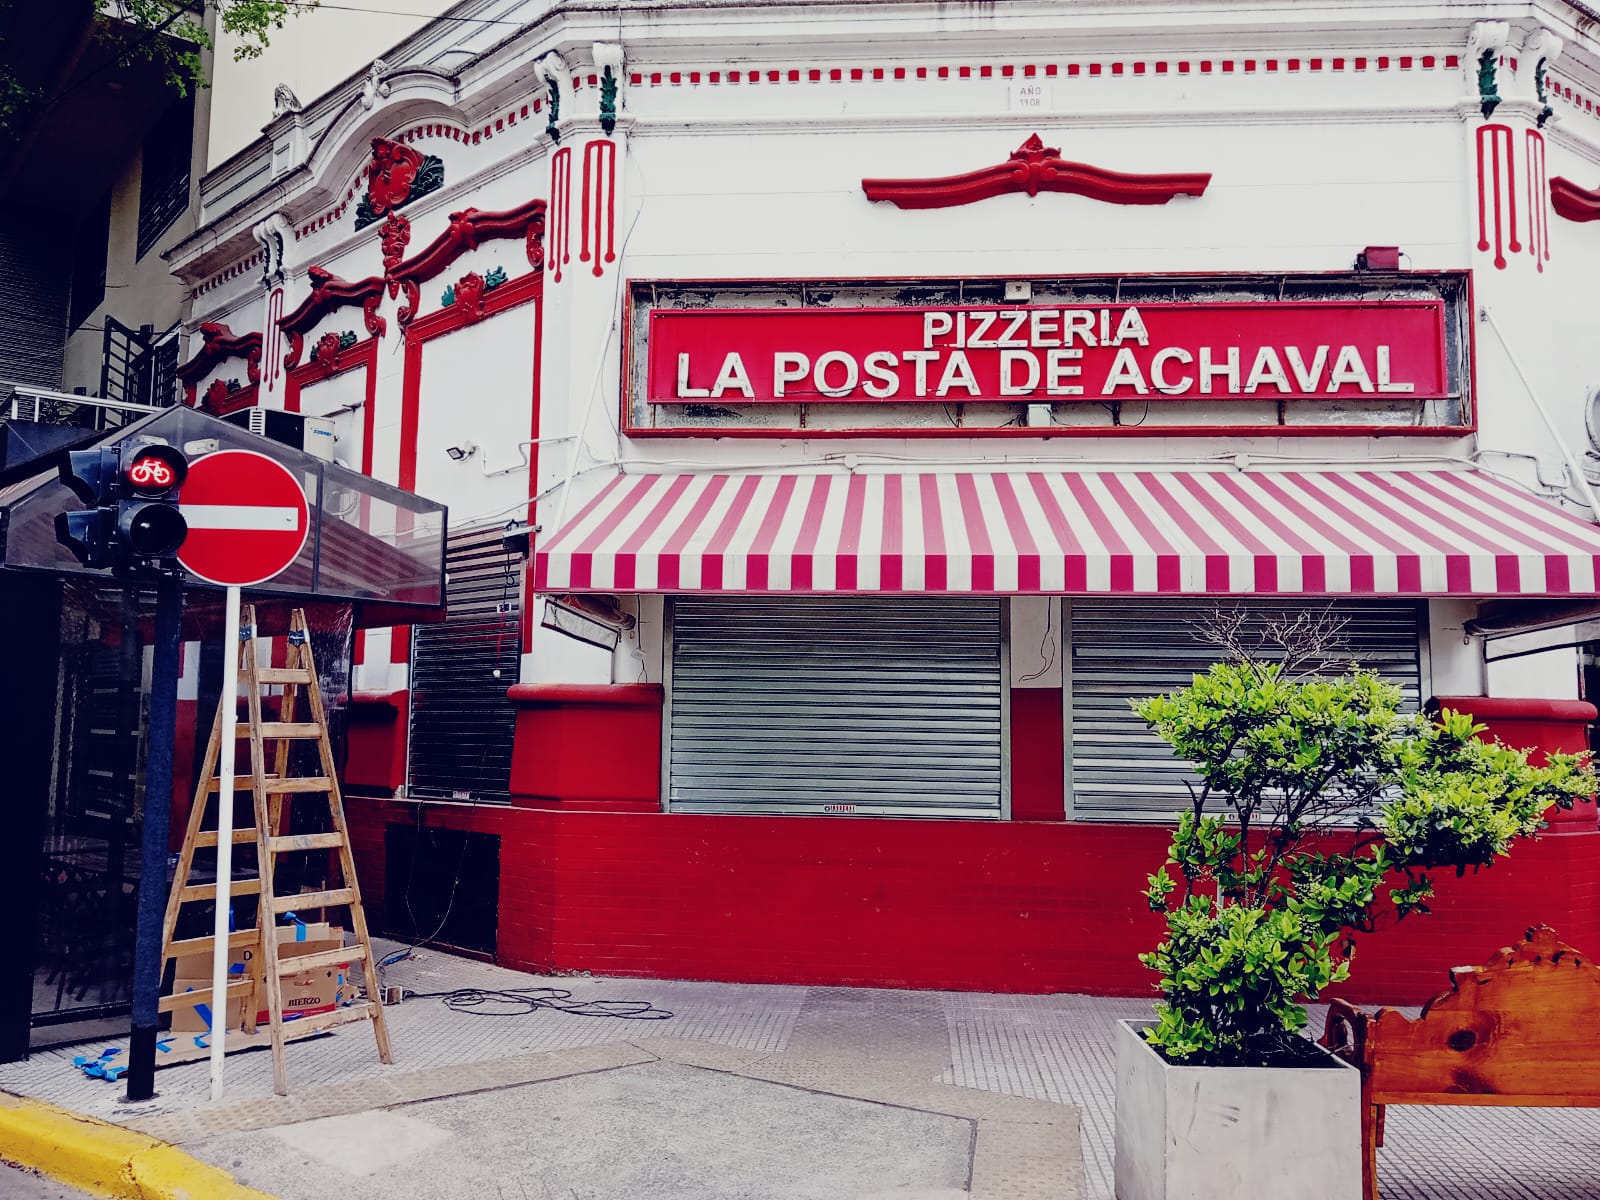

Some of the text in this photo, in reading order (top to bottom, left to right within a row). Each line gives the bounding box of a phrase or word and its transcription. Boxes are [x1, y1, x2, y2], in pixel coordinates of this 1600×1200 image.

[923, 306, 1149, 349] PIZZERIA
[677, 345, 1414, 398] LA POSTA DE ACHAVAL
[288, 997, 321, 1007] BIERZO
